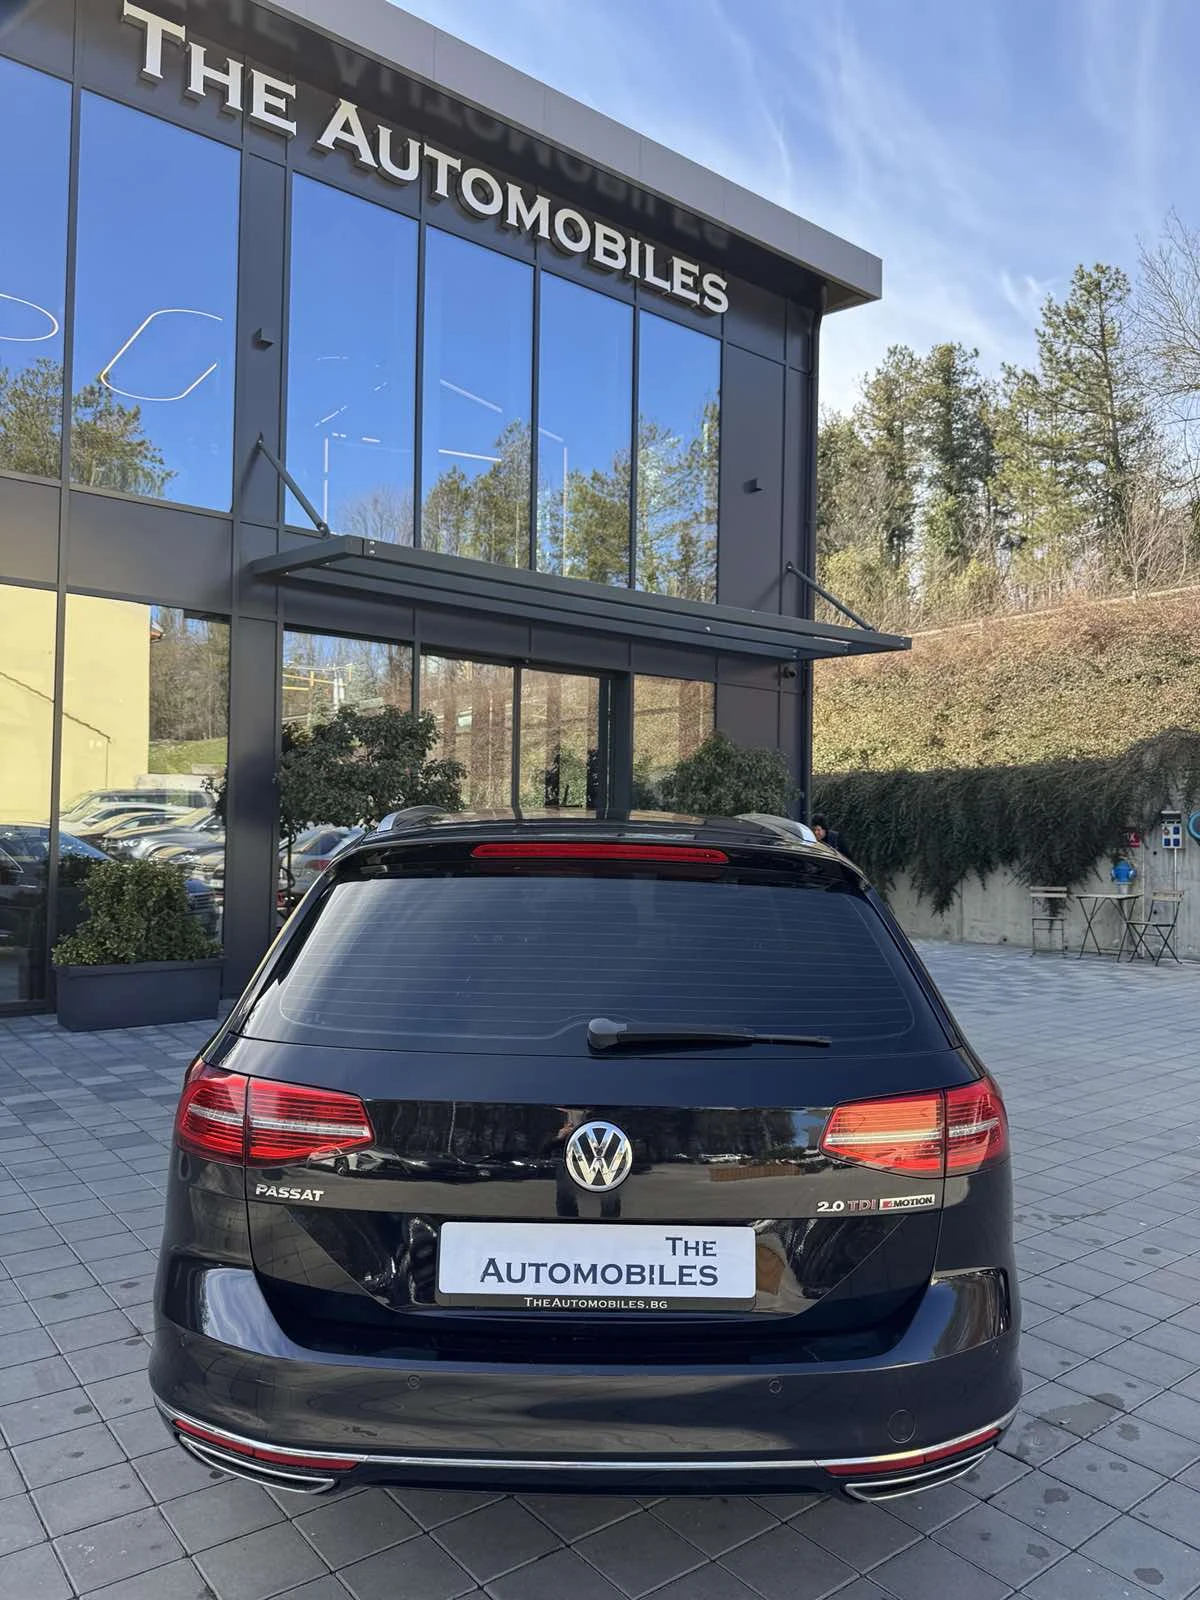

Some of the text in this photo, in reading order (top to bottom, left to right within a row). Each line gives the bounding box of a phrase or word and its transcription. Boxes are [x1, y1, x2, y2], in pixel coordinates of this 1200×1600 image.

[123, 0, 297, 136] THE
[316, 98, 729, 315] AUTOMOBILES
[255, 1183, 325, 1202] PASSAT
[847, 1199, 877, 1211] TDI
[665, 1236, 717, 1257] THE
[480, 1257, 718, 1287] AUTOMOBILES
[524, 1296, 668, 1310] THEAUTOMOBILES.BG
